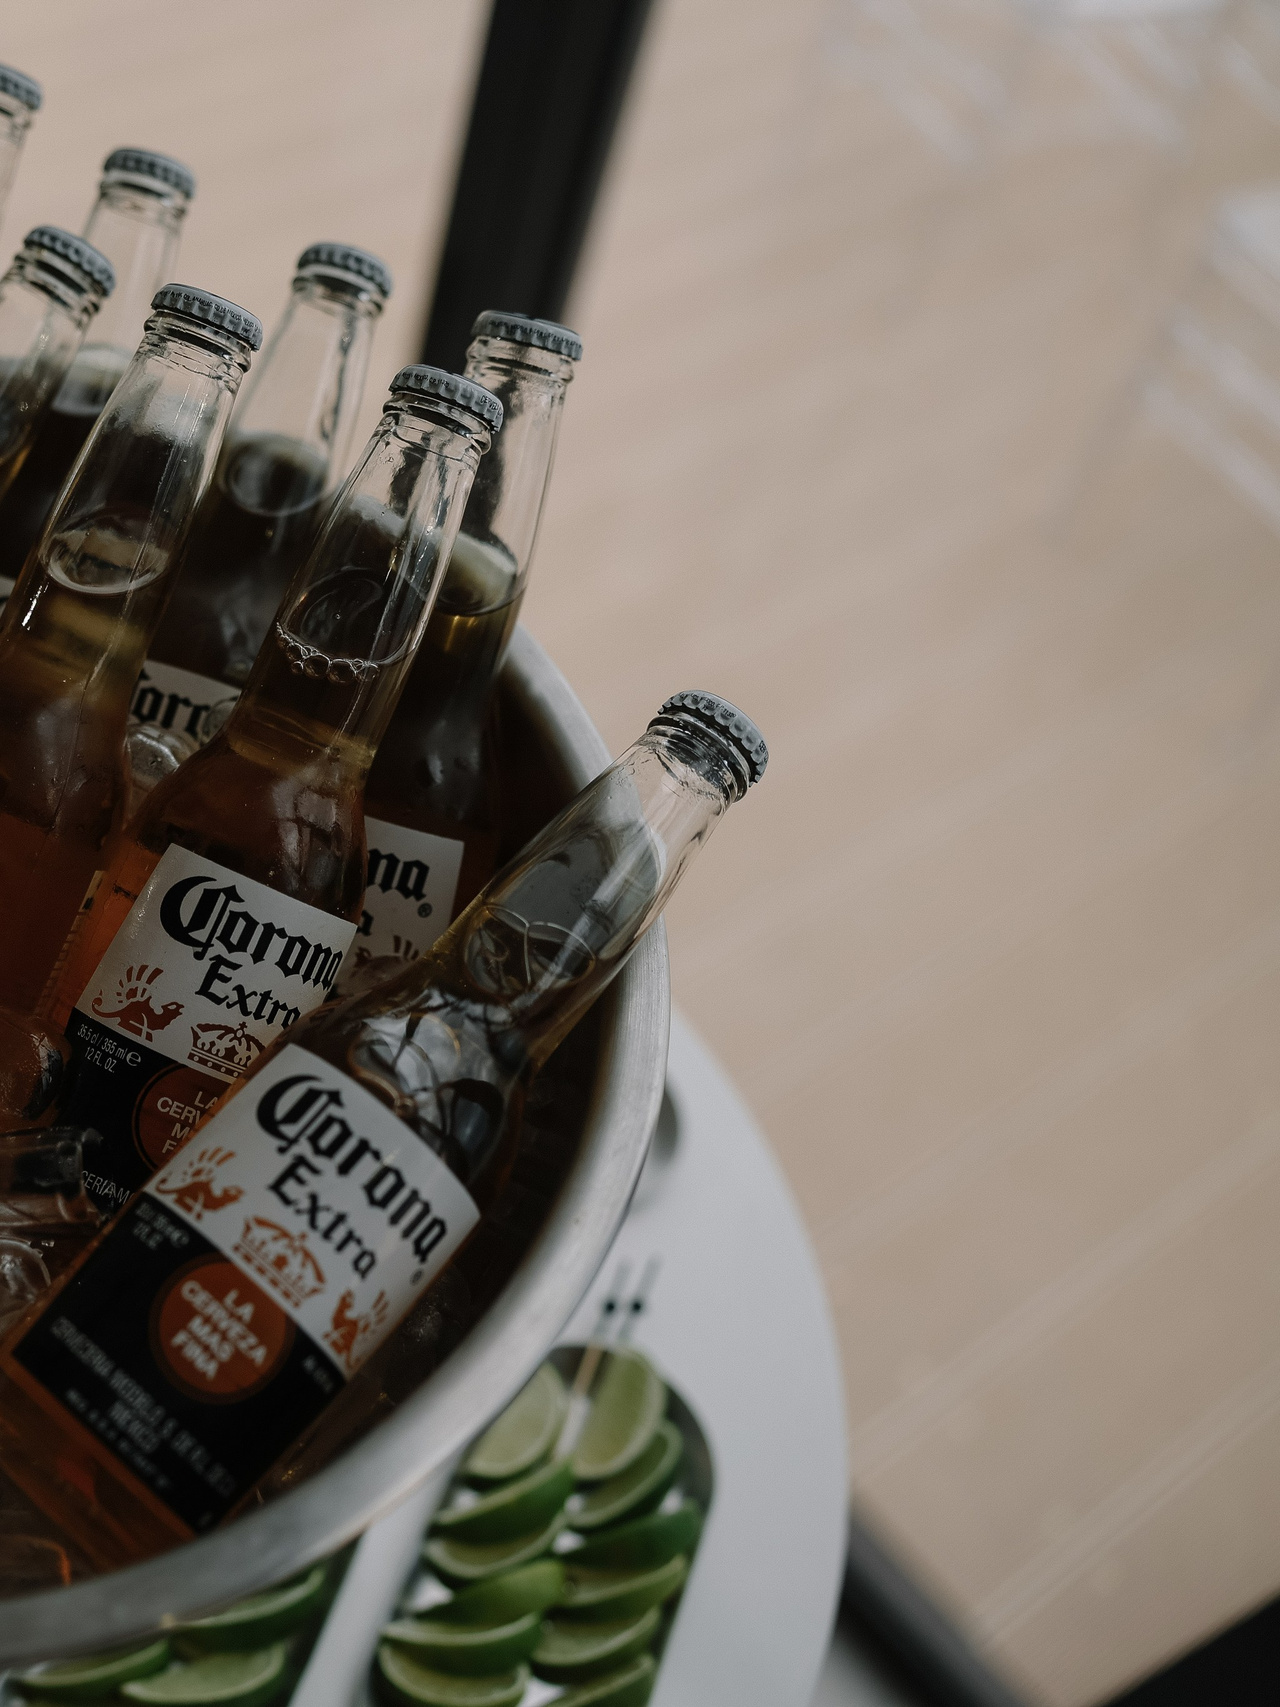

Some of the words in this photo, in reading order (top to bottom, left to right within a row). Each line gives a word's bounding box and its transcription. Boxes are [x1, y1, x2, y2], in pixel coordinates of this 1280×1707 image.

[160, 875, 344, 992] Corona
[84, 1046, 95, 1060] 12
[101, 1037, 117, 1054] 355
[257, 1074, 447, 1264] Corona
[268, 1155, 376, 1280] Extra
